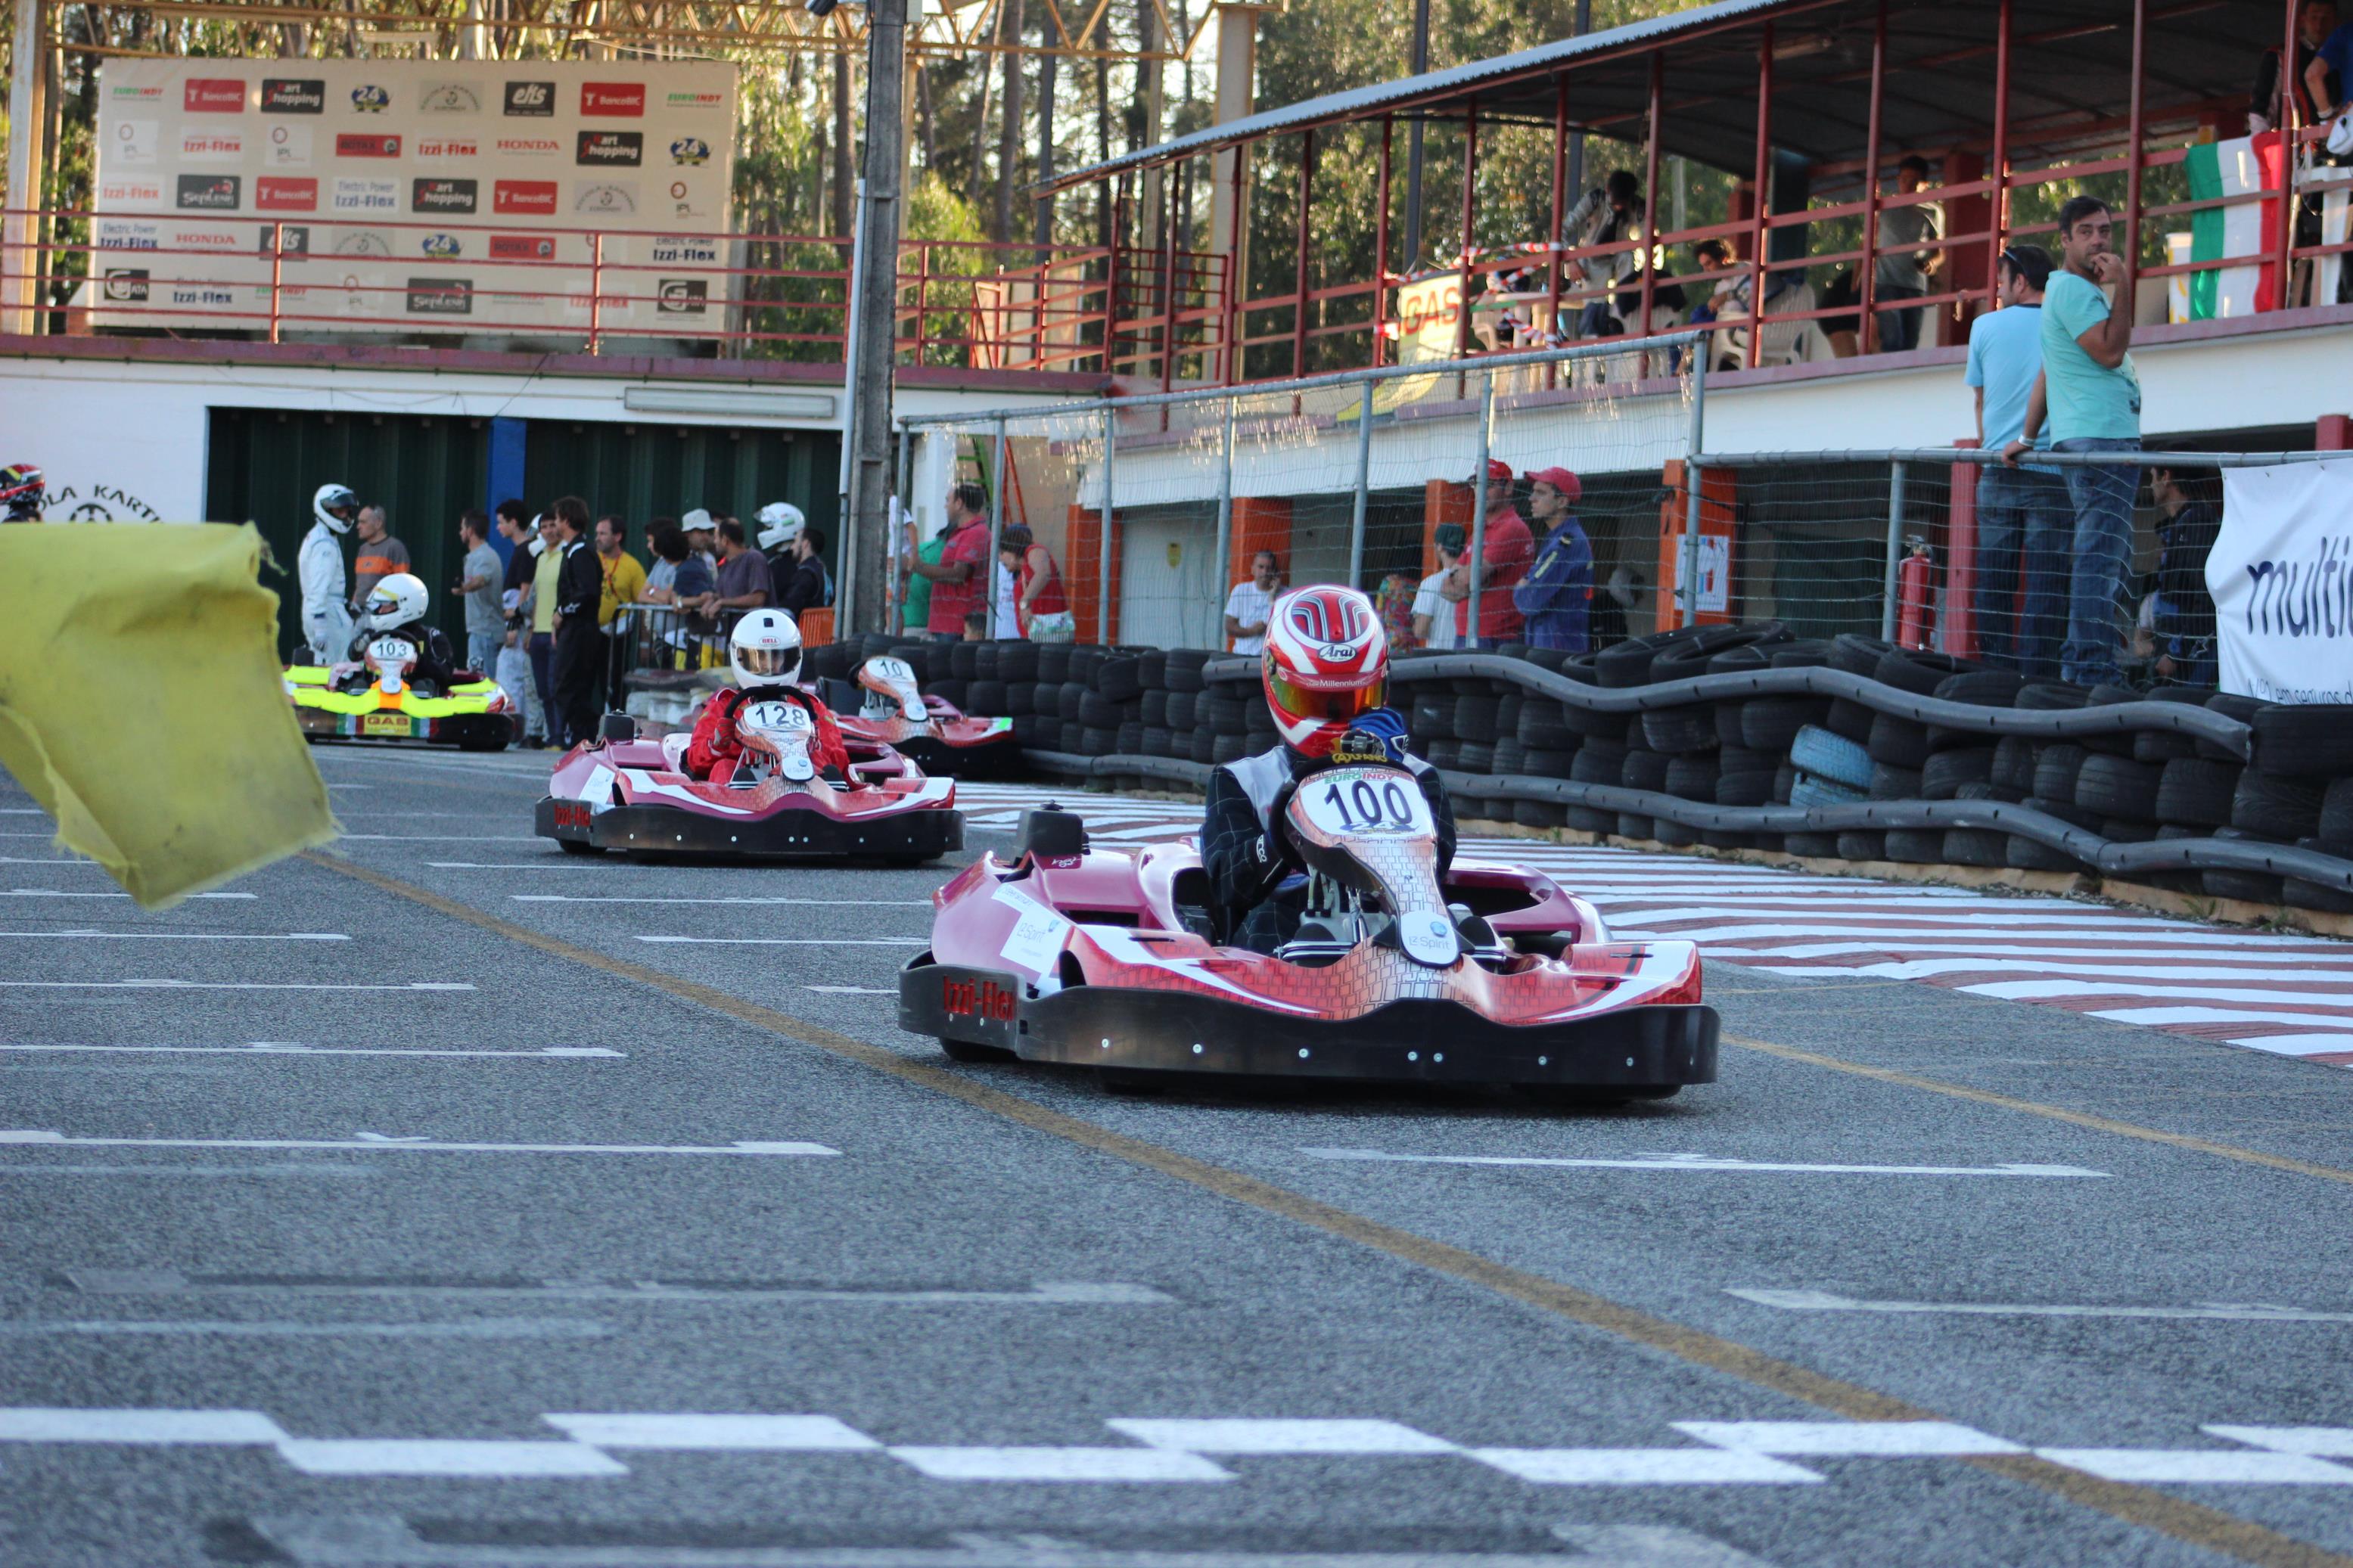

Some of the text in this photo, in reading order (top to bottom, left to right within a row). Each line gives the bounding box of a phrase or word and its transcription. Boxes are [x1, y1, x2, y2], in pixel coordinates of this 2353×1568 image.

[497, 139, 559, 151] HONDA
[581, 141, 639, 160] Shopping
[338, 181, 394, 192] Electric Power
[417, 188, 473, 206] Shopping
[176, 234, 235, 244] HONDA
[654, 249, 716, 262] Izzi-Flex
[173, 292, 232, 304] Izzi-Flex
[1405, 287, 1459, 334] GAS
[2246, 536, 2353, 638] multi
[378, 643, 407, 657] 103
[1319, 645, 1354, 657] Arai
[1319, 678, 1363, 687] Millennium
[756, 706, 806, 726] 128
[1324, 772, 1394, 784] EUROINDY
[1324, 780, 1413, 825] 100
[1420, 936, 1450, 950] Spirit
